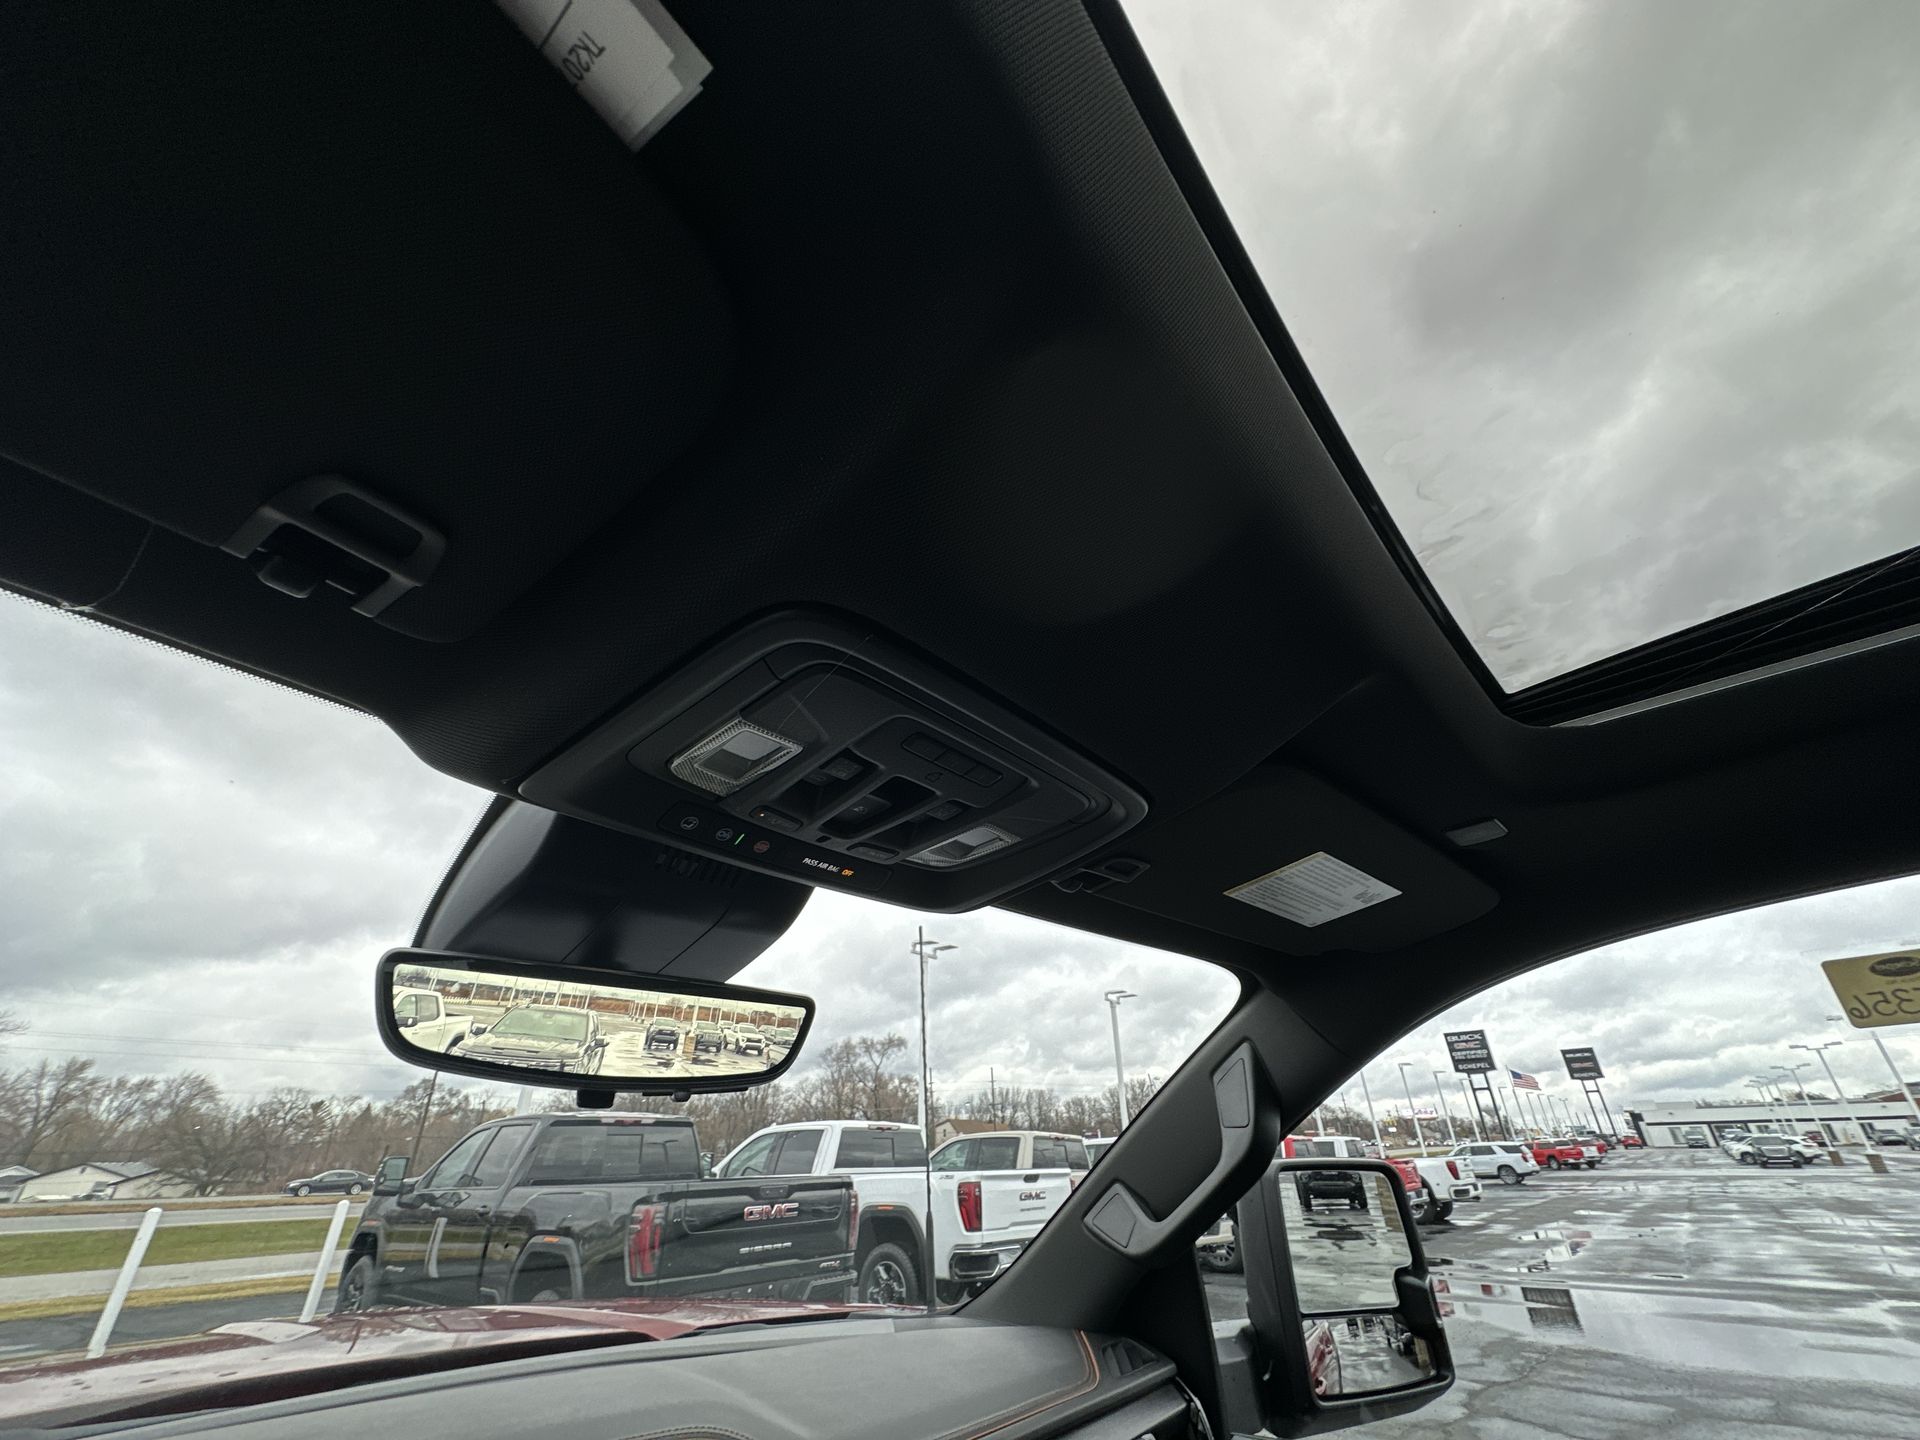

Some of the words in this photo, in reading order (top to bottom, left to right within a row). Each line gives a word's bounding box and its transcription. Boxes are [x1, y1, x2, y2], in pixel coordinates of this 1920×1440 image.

[802, 857, 819, 867] PASS
[817, 861, 829, 870] AIR
[827, 864, 840, 873] BAG
[1446, 1033, 1483, 1042] BUICK
[1454, 1041, 1480, 1049] GMC
[1452, 1049, 1488, 1057] CERTIFIED
[1457, 1062, 1491, 1070] SCHEPEL
[1019, 1190, 1047, 1201] GMC
[743, 1202, 800, 1221] GMC
